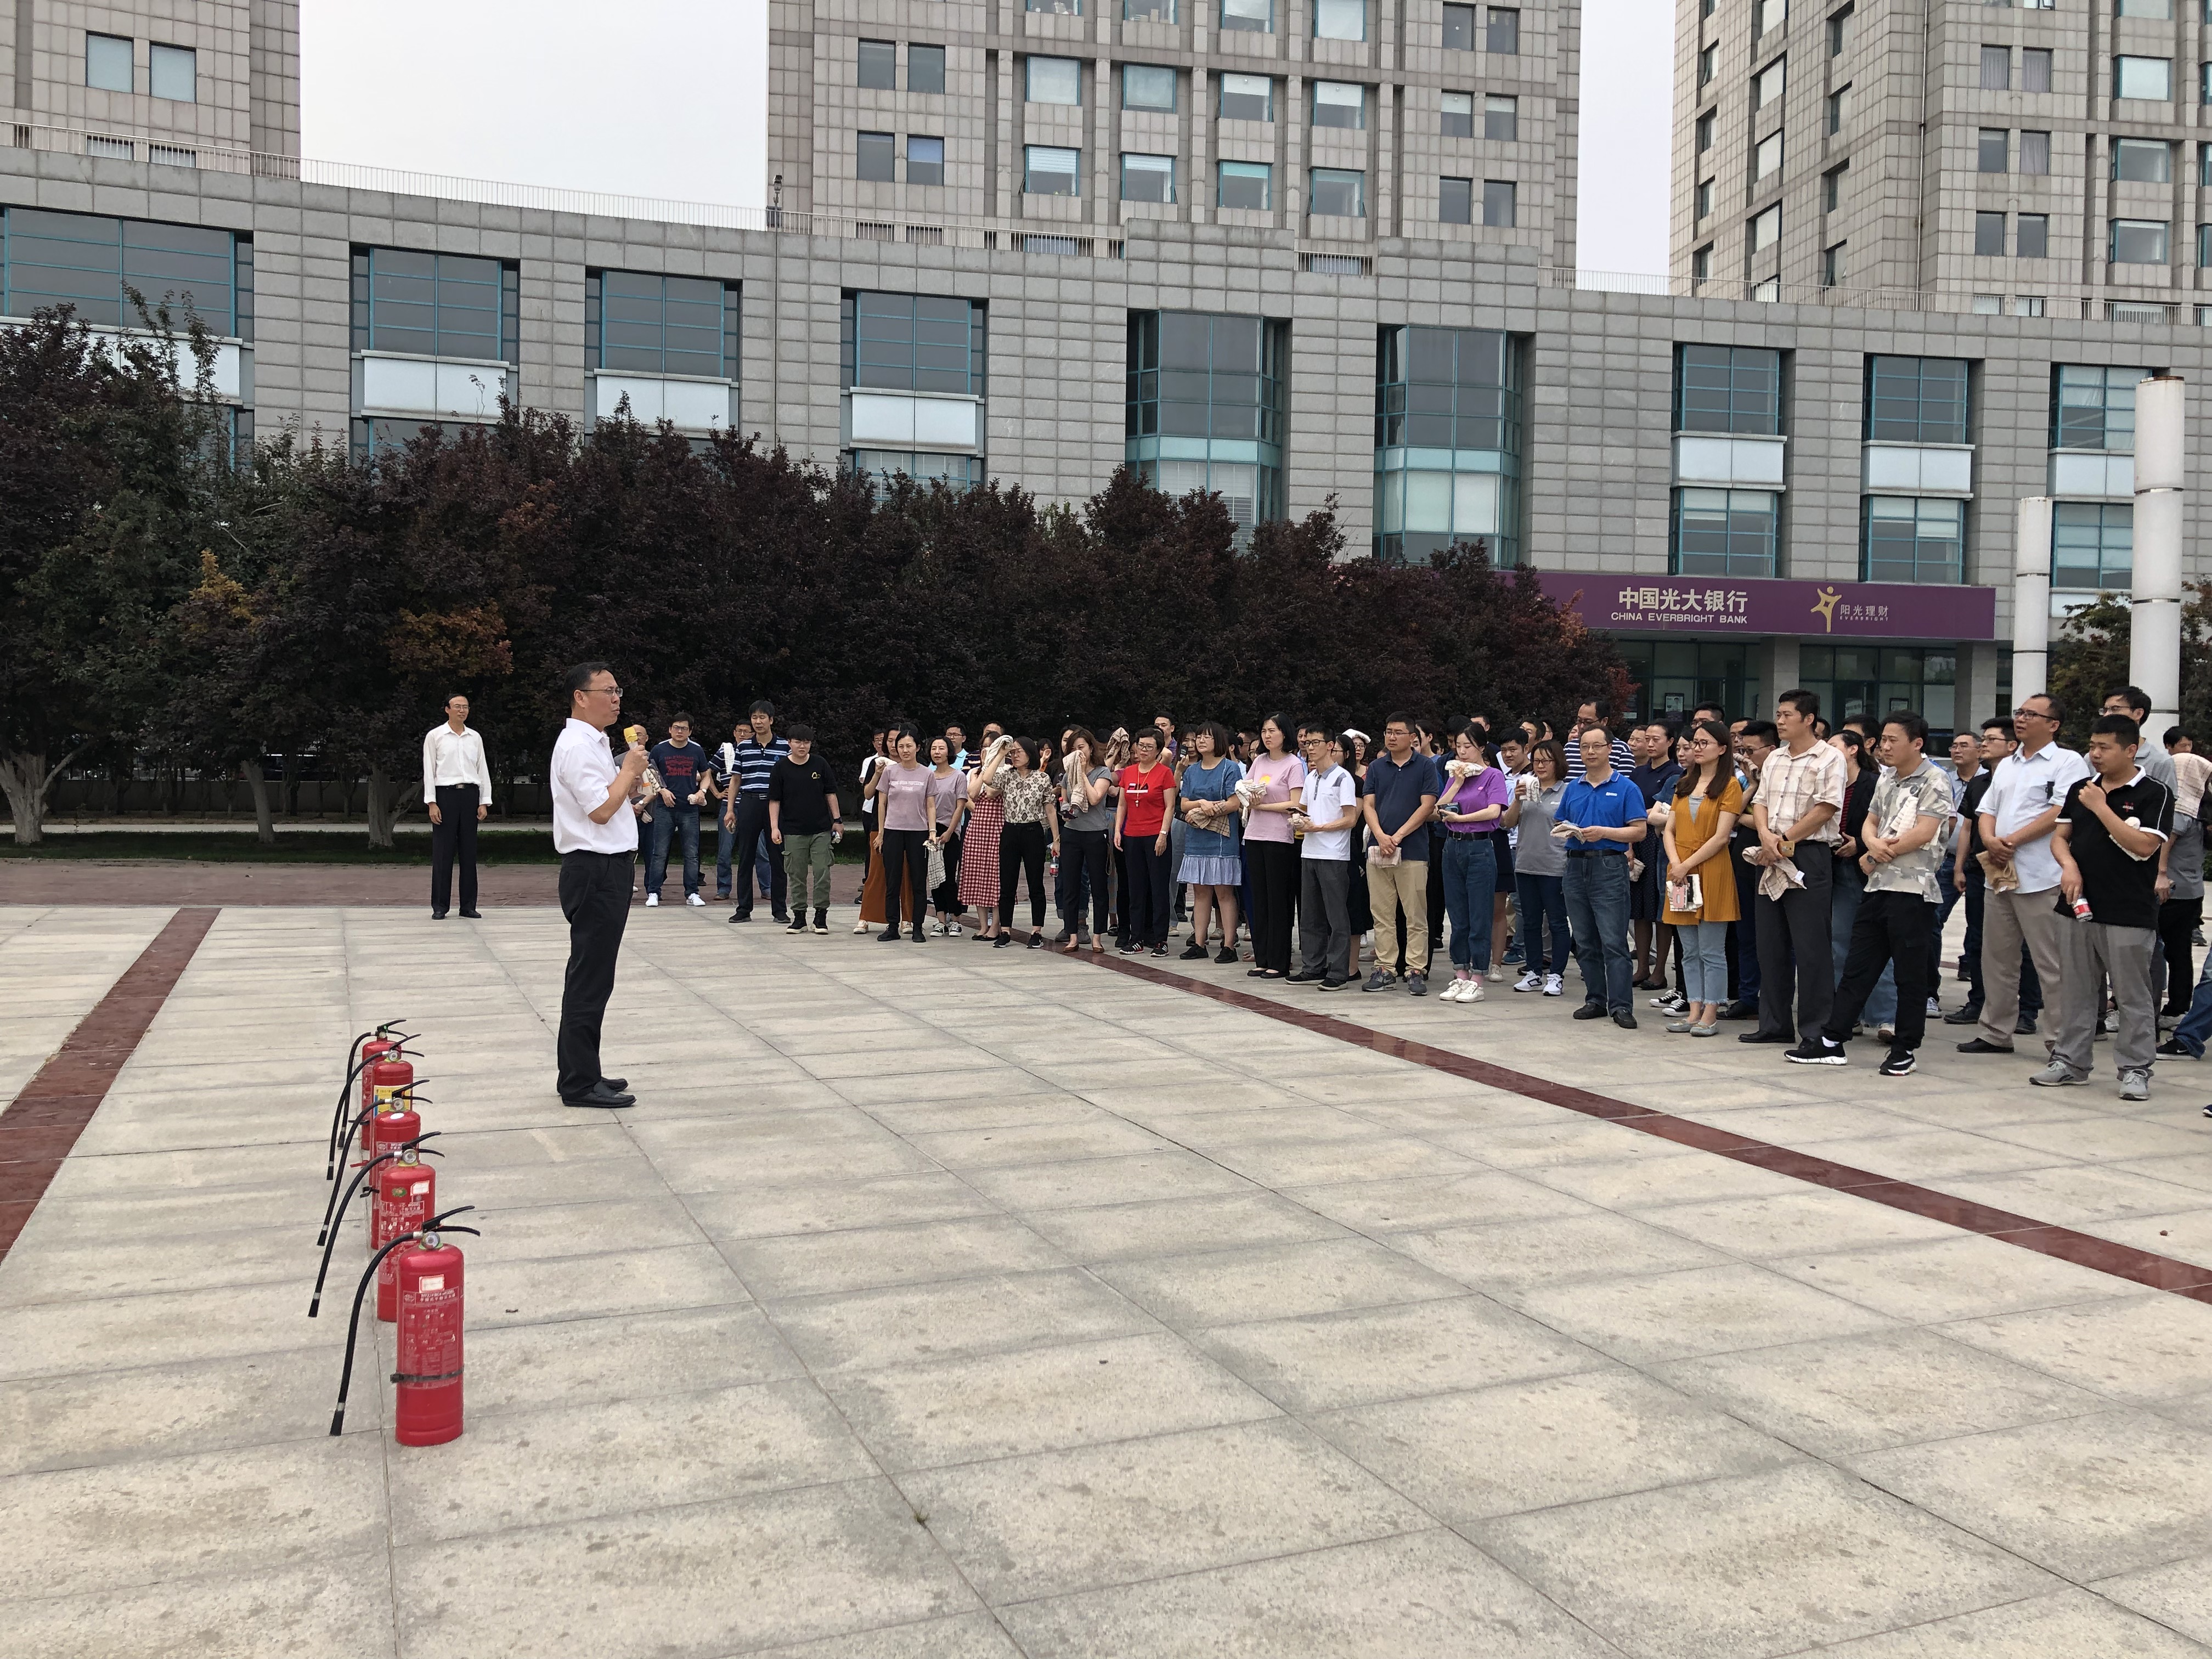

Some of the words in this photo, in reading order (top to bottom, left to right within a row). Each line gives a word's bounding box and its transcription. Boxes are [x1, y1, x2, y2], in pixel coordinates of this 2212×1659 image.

[1618, 586, 1748, 613] 中国光大银行
[1840, 604, 1888, 617] 阳光理财
[1611, 612, 1643, 621] CHINA
[1648, 612, 1714, 623] EVERBRIGHT
[1719, 615, 1748, 624] BANK
